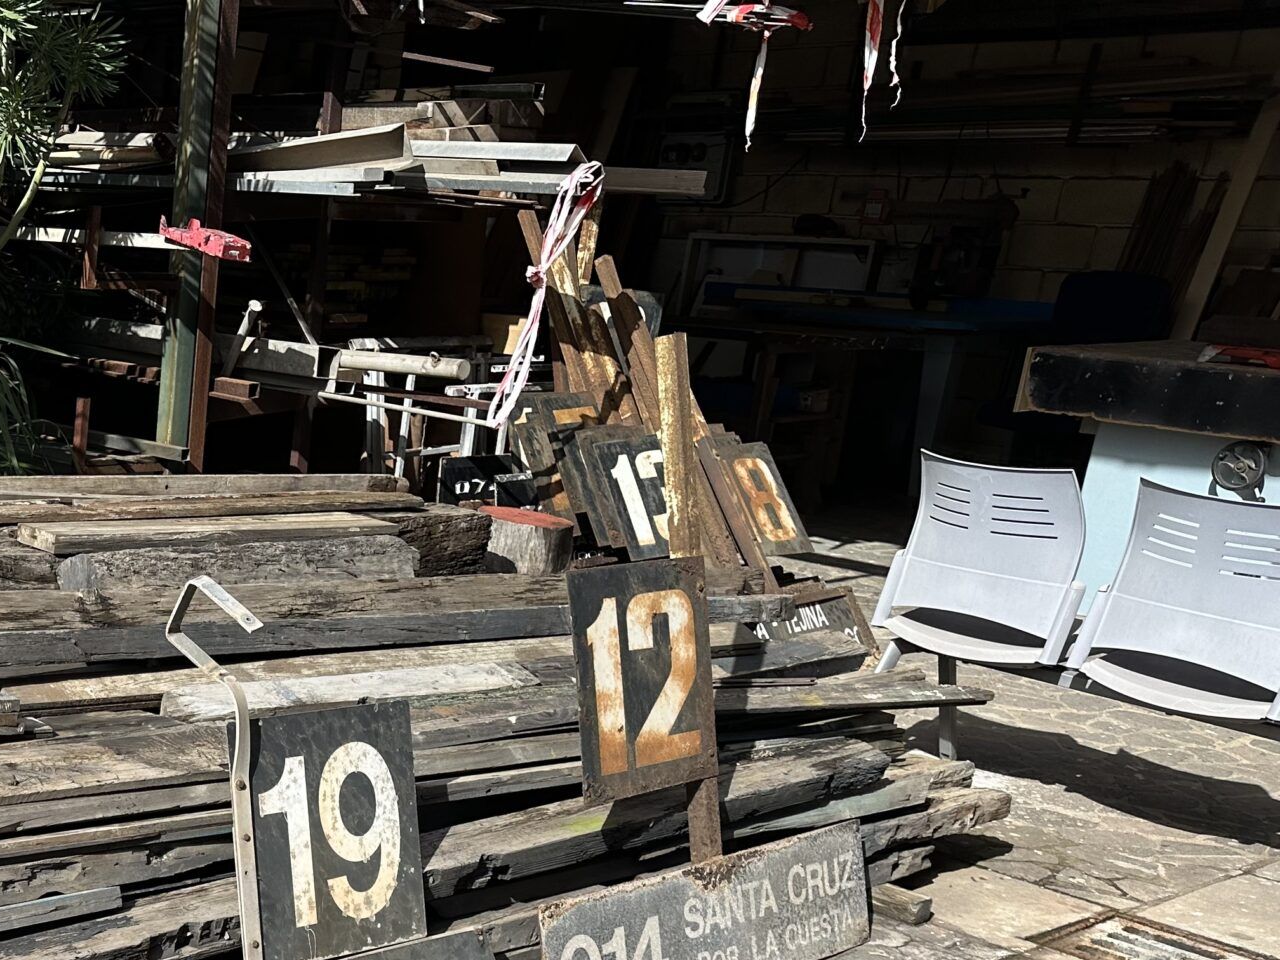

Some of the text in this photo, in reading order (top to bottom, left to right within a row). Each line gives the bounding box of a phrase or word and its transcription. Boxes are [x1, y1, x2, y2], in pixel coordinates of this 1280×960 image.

[454, 478, 495, 495] 07
[725, 457, 798, 543] 8
[586, 588, 702, 776] 12
[258, 741, 401, 928] 19
[683, 850, 857, 939] SANTA CRUZ
[785, 901, 854, 950] CUESTA
